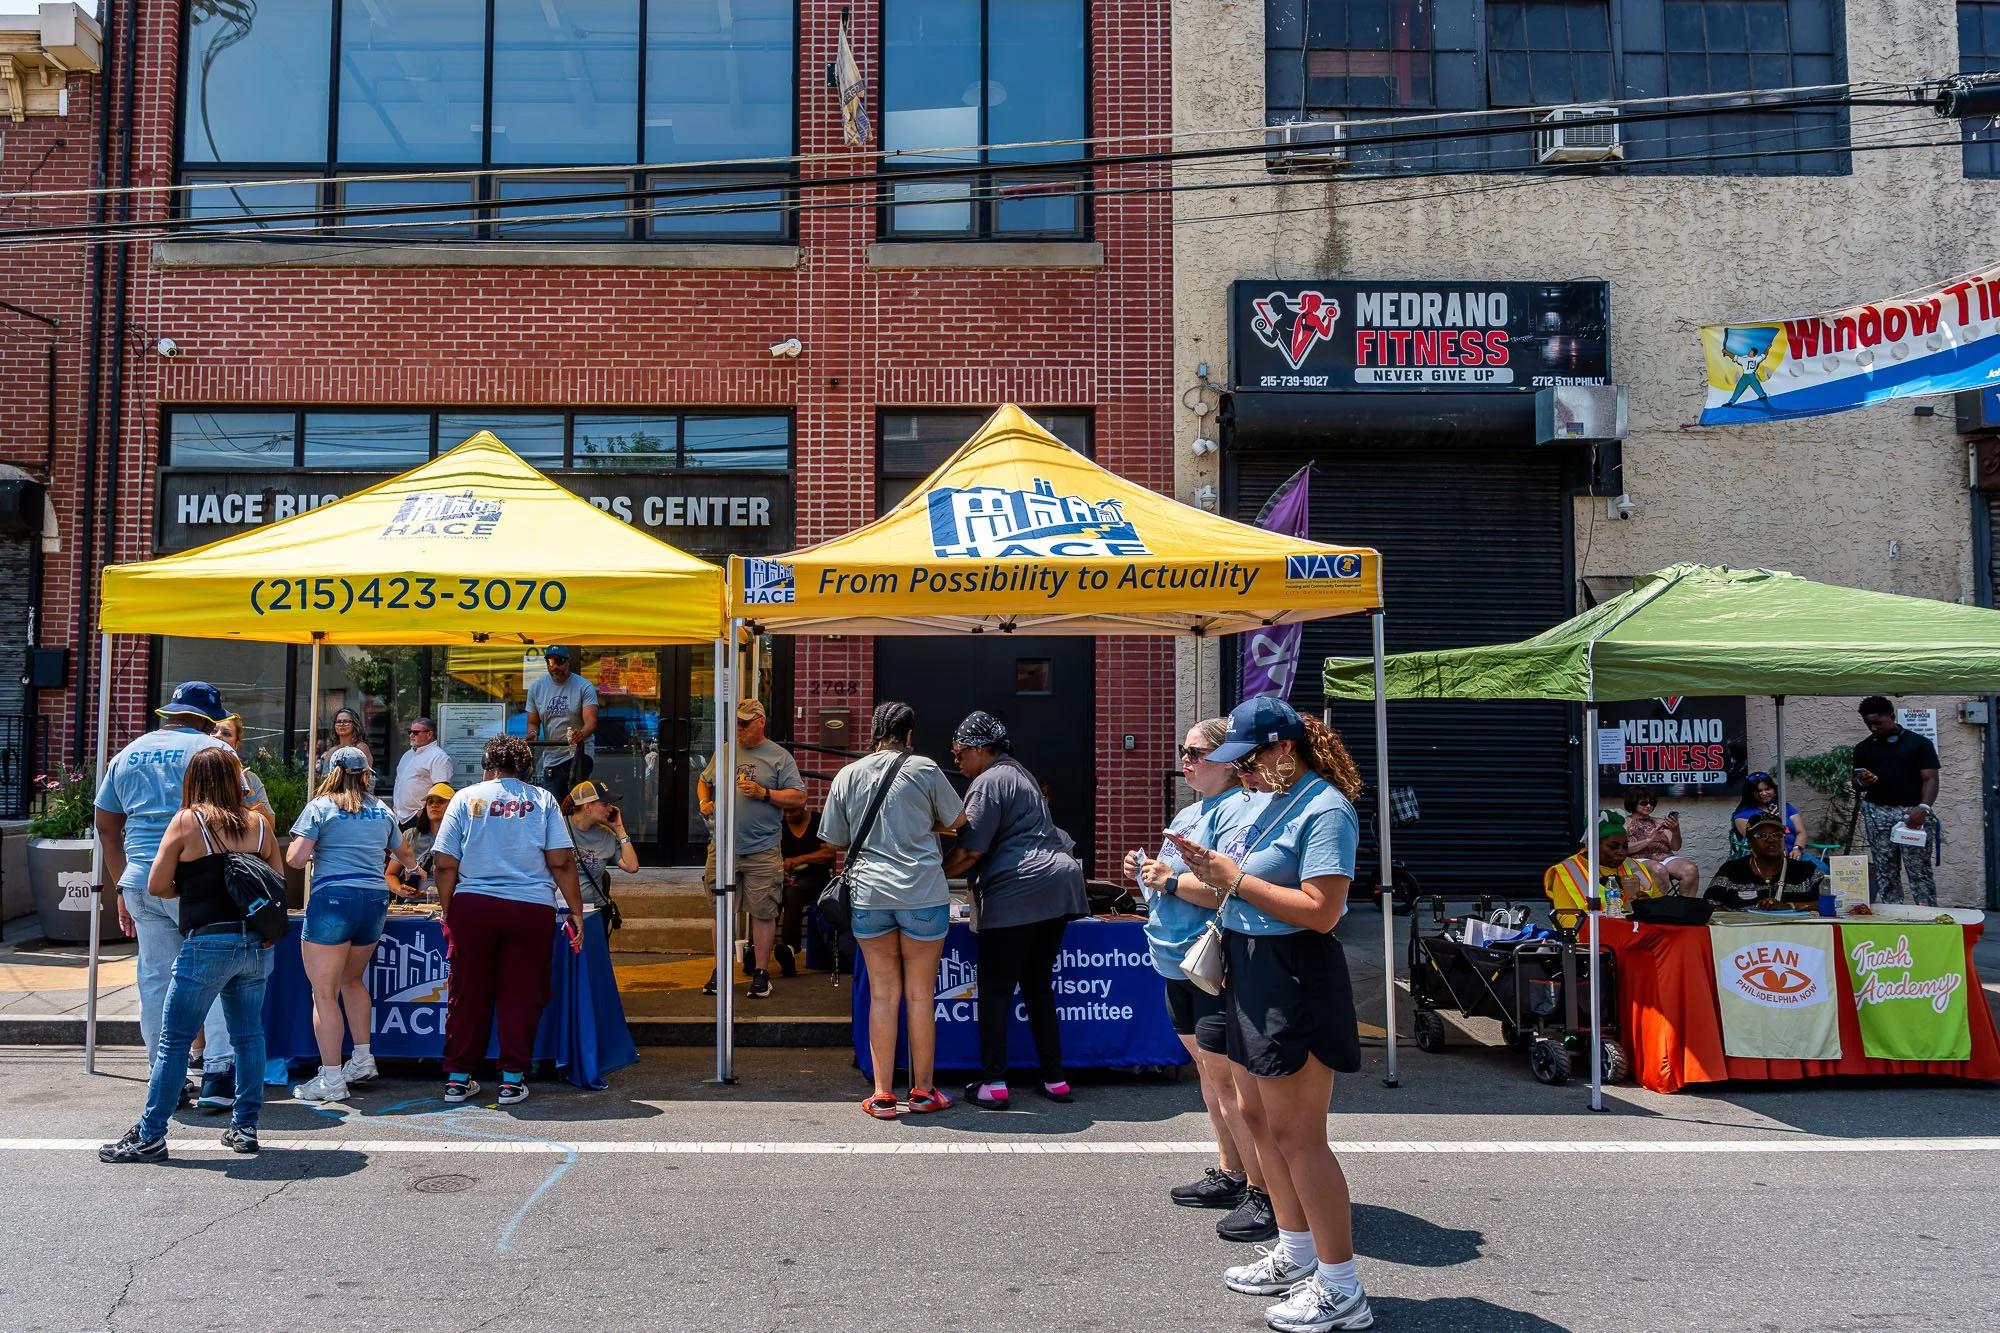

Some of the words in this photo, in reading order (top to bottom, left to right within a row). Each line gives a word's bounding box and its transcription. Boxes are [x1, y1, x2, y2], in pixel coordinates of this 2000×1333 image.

[1356, 292, 1508, 327] MEDRANO
[1784, 298, 1941, 360] Window
[1356, 330, 1510, 366] FITNESS
[1260, 375, 1329, 387] 215-739-9027
[1373, 370, 1423, 382] NEVER
[1431, 370, 1466, 382] GIVE
[1474, 370, 1495, 382] UP
[1532, 376, 1554, 386] 2712
[1555, 376, 1574, 386] 5TH
[1575, 376, 1605, 387] PHILLY
[177, 494, 263, 524] HACE
[643, 496, 770, 527] CENTER
[382, 523, 497, 535] HACE
[935, 542, 1154, 557] HACE
[1286, 554, 1360, 579] NAC
[744, 591, 795, 603] HACE
[818, 568, 898, 594] From
[909, 564, 1070, 599] Possibility
[1077, 566, 1109, 590] to
[1116, 561, 1260, 596] Actuality
[250, 578, 567, 616] (215)423-3070
[811, 680, 857, 695] 2708
[1619, 718, 1723, 743] MEDRANO
[128, 749, 185, 766] STAFF
[1626, 772, 1665, 783] NEVER
[1671, 772, 1697, 783] GIVE
[1703, 772, 1720, 783] UP
[68, 886, 89, 897] 250
[1735, 947, 1799, 971] CLEAN
[1852, 935, 1912, 974] Trash
[1736, 979, 1798, 1003] PHILADELPHIA
[1800, 984, 1817, 1001] NOW
[1856, 973, 1960, 1012] Academy
